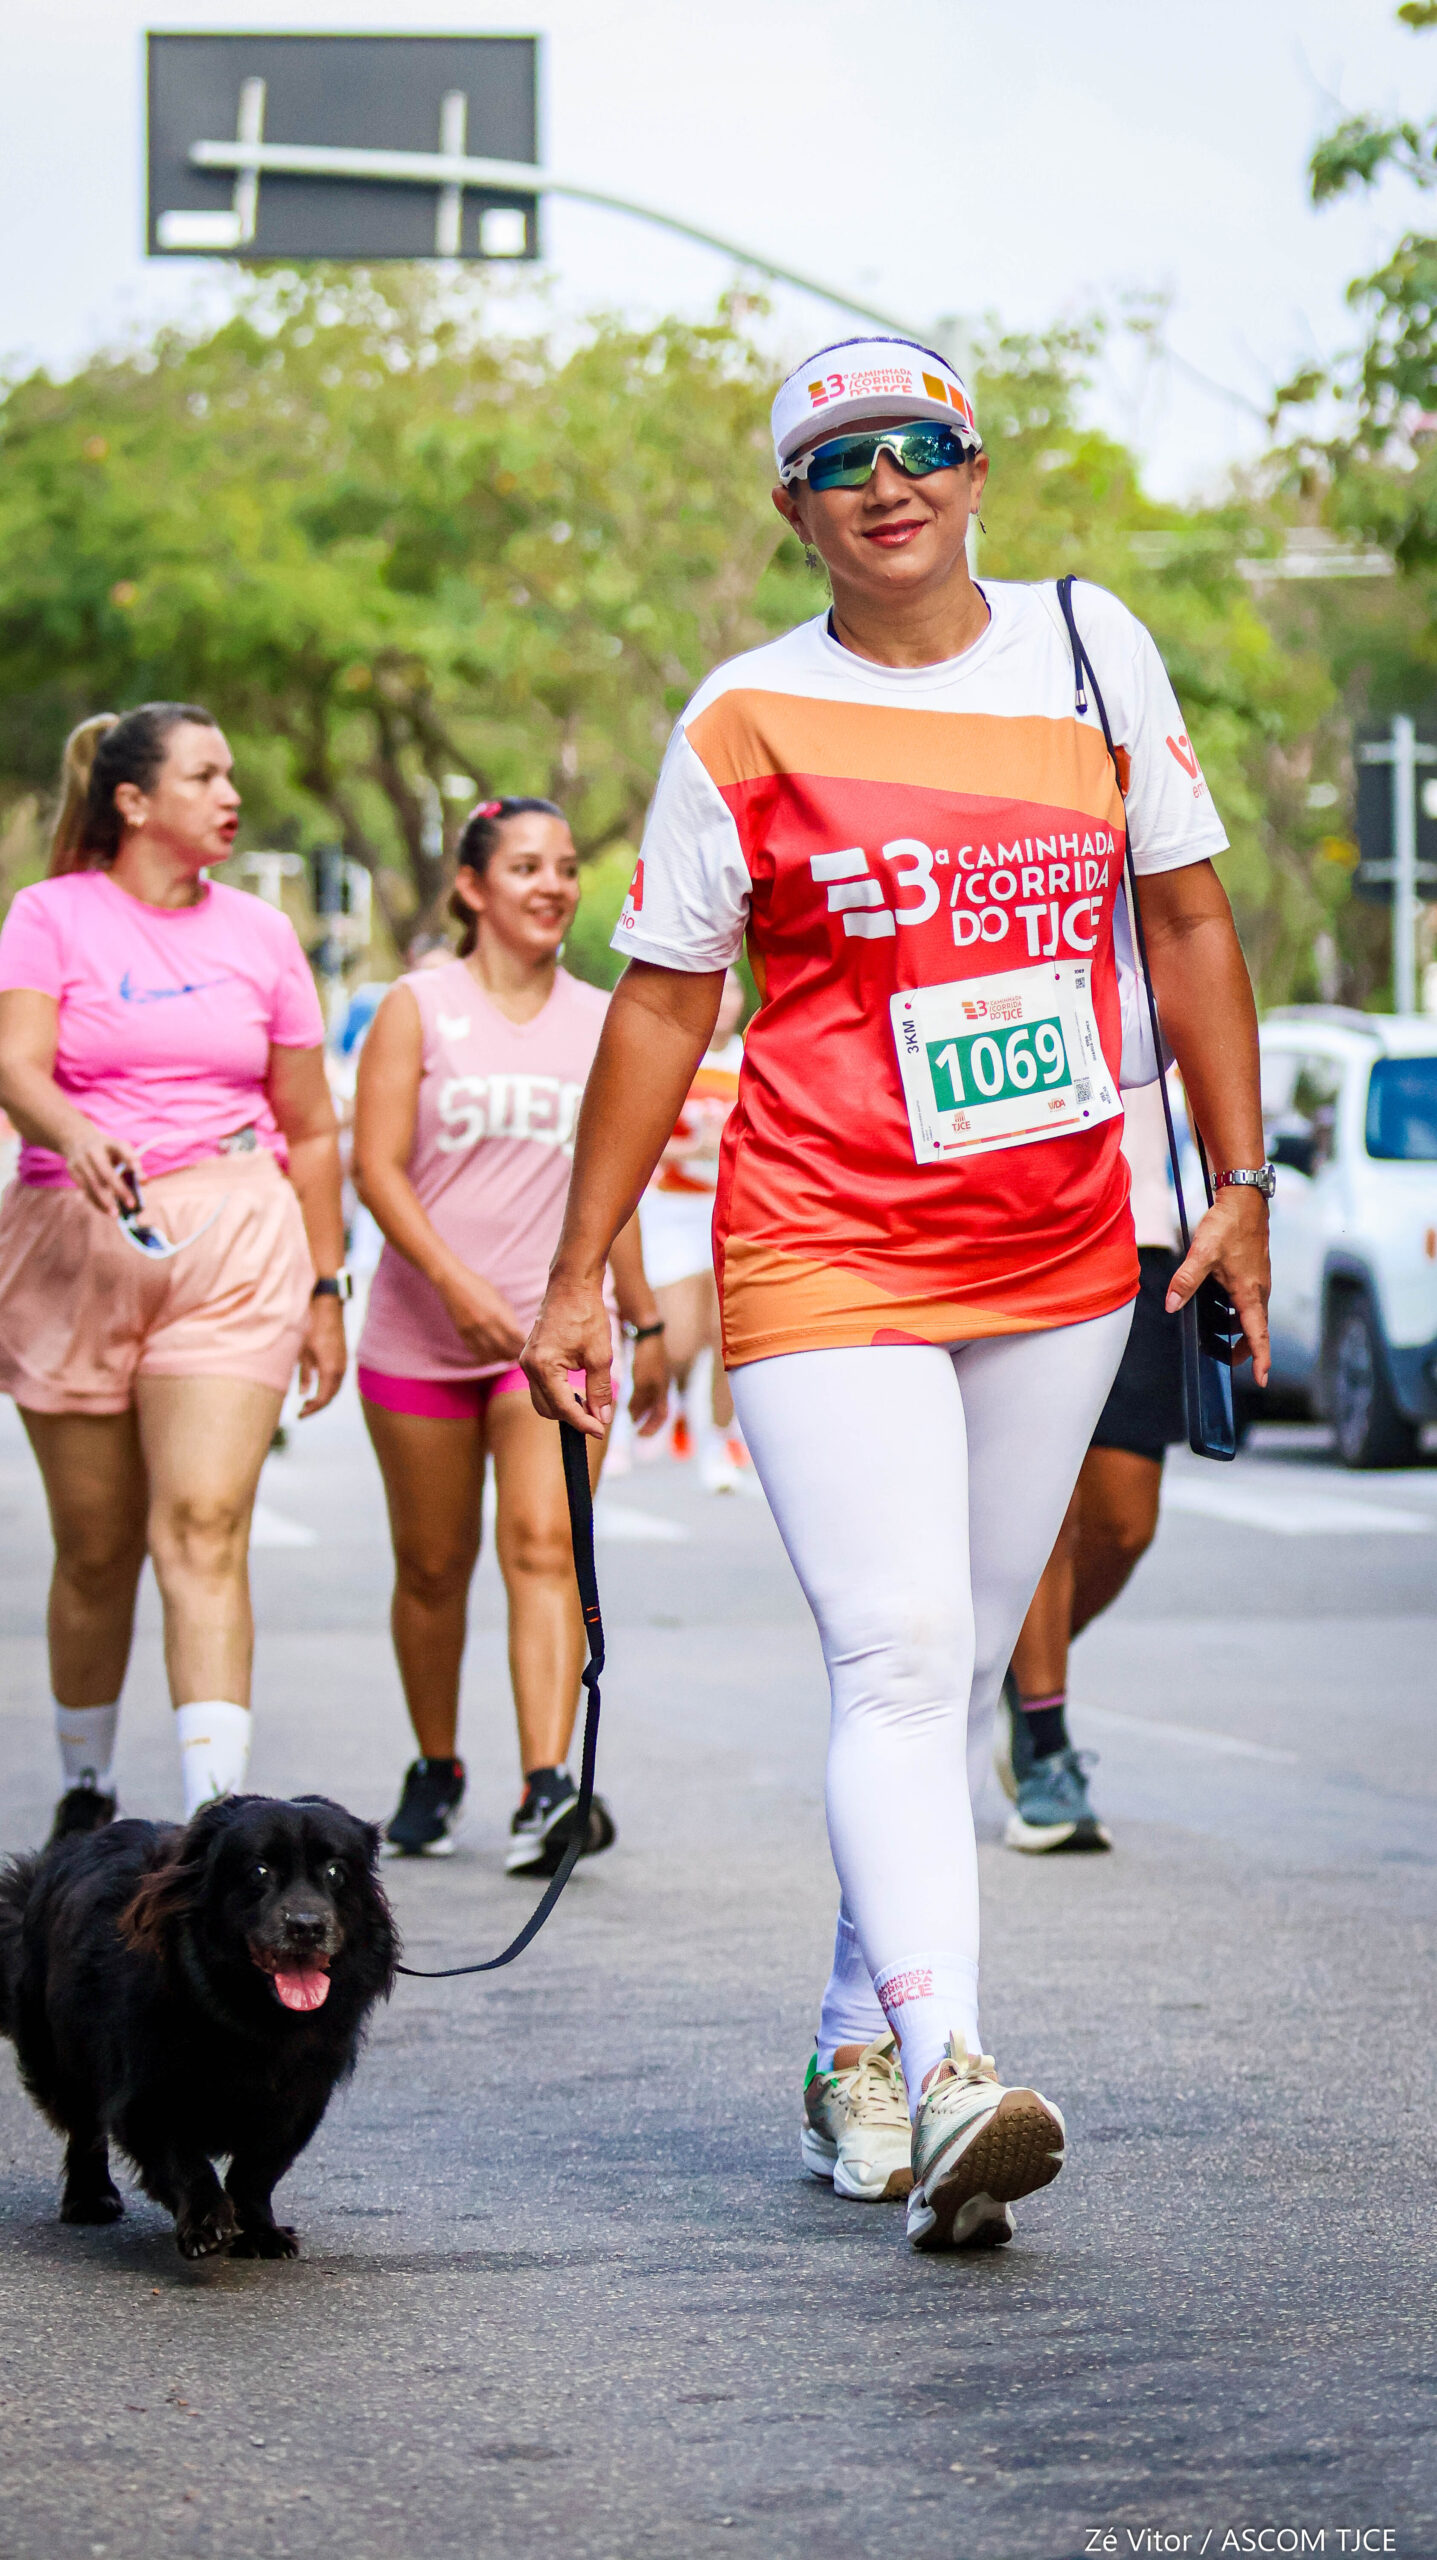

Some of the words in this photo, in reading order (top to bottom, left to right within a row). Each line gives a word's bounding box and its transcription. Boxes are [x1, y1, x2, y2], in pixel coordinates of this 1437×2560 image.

[851, 368, 912, 380] CAMINHADA
[882, 839, 949, 926] 3ª
[958, 832, 1115, 870] CAMINHADA
[950, 860, 1109, 908] /CORRIDA
[951, 906, 1009, 947] DO
[1015, 896, 1103, 957] TJCE
[990, 1011, 1001, 1020] DO
[1002, 1007, 1023, 1022] TJCE
[902, 1019, 919, 1054] 3KM
[934, 1023, 1065, 1103] 1069
[952, 1120, 971, 1132] TJCE
